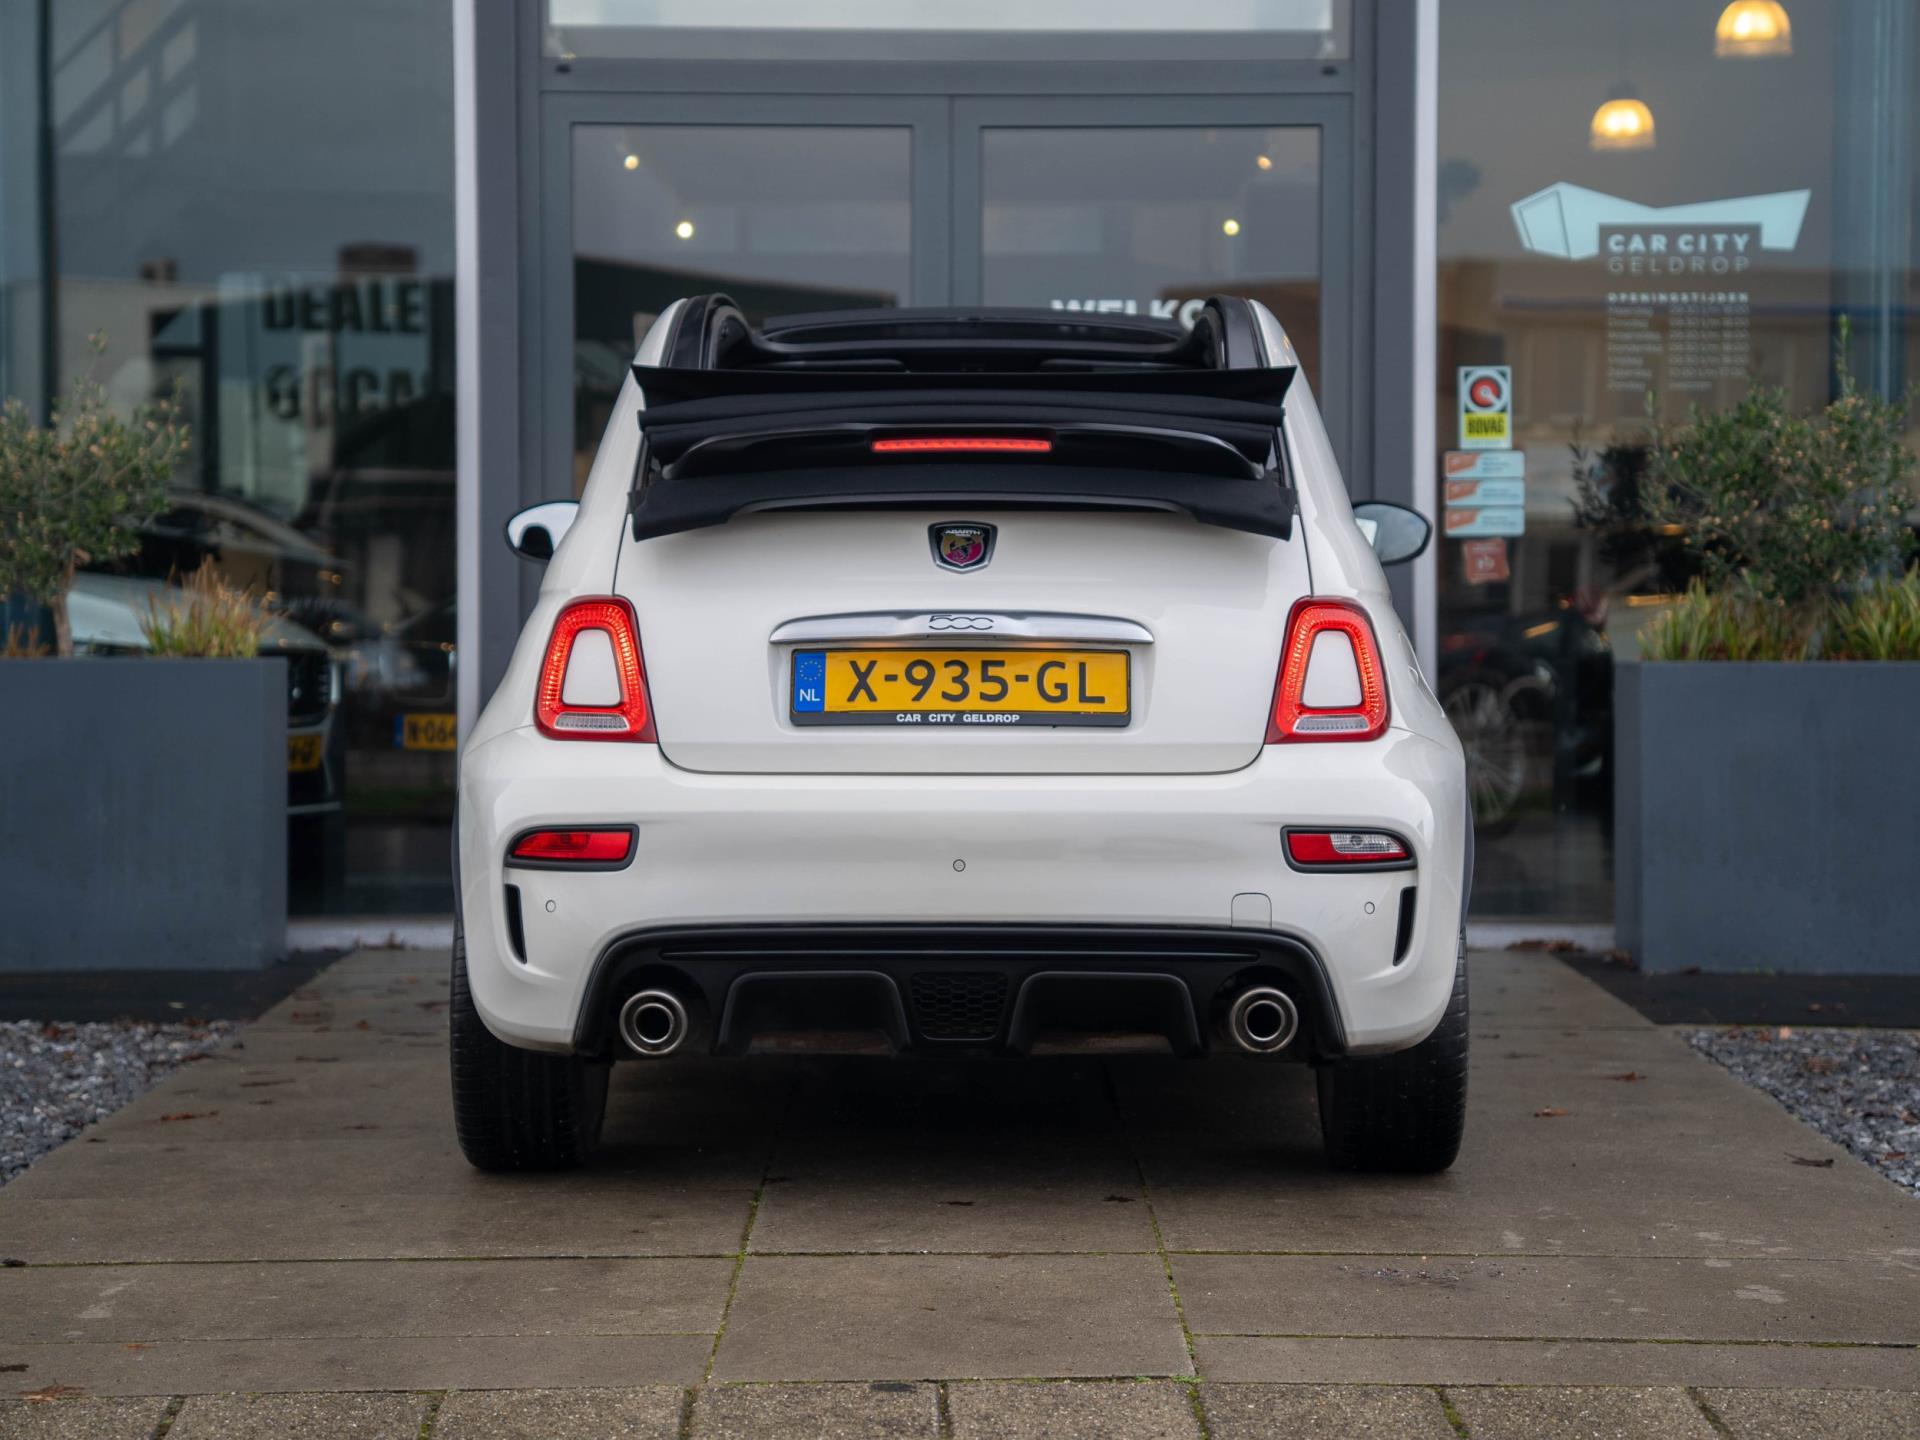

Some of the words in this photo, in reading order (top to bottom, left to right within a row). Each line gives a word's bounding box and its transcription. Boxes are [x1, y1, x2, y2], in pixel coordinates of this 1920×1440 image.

[1608, 233, 1667, 252] CAR
[1678, 233, 1749, 252] CITY
[1608, 255, 1749, 274] GELDROP
[1468, 416, 1504, 434] BOVAG
[929, 614, 994, 630] 500
[799, 688, 820, 702] NL
[847, 659, 1106, 704] X-935-GL
[896, 713, 921, 723] CAR
[929, 713, 956, 723] CITY
[963, 713, 1020, 723] GELDROP
